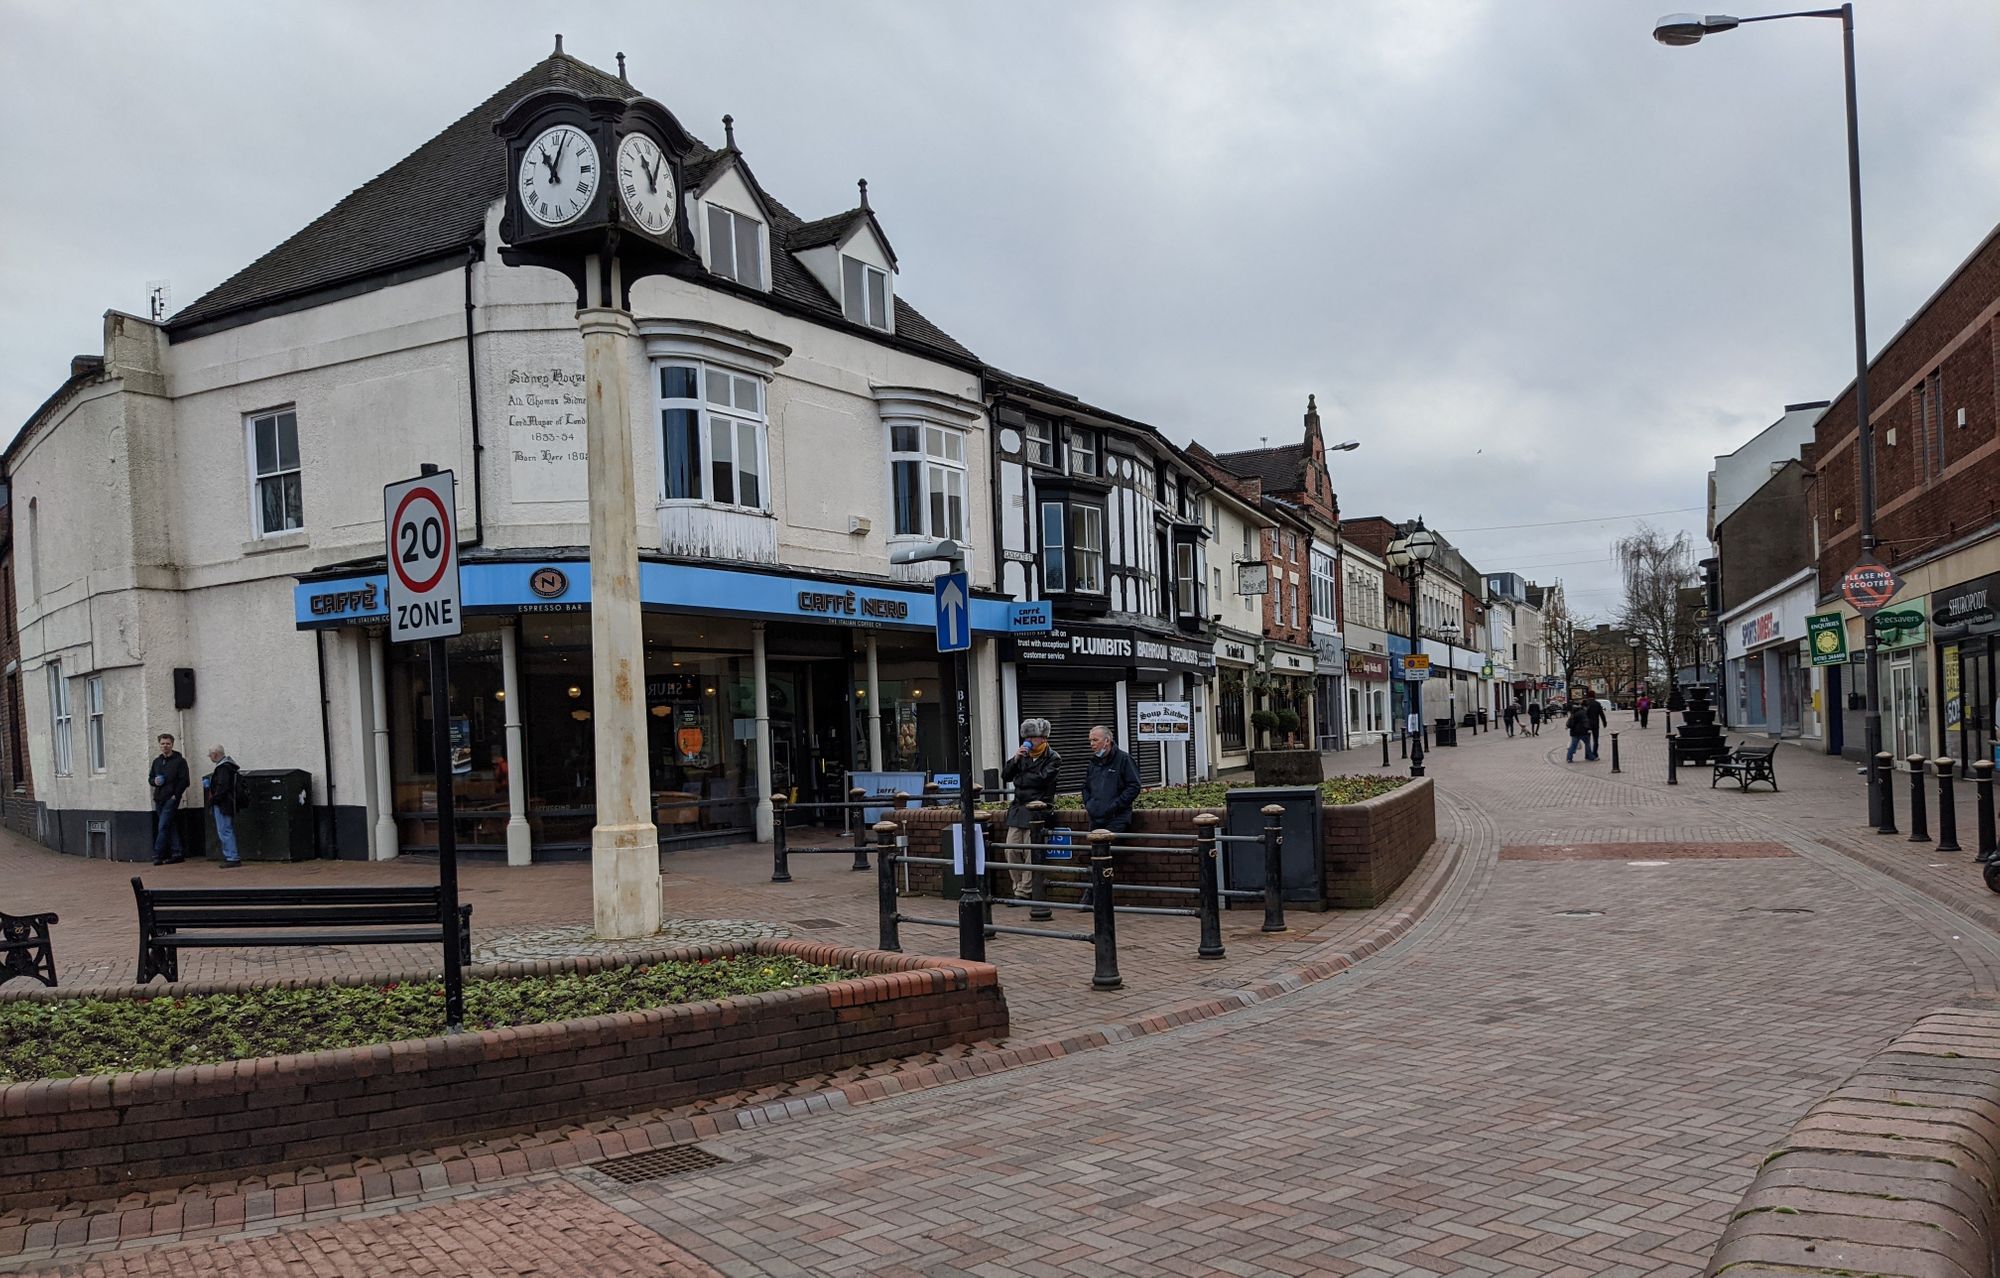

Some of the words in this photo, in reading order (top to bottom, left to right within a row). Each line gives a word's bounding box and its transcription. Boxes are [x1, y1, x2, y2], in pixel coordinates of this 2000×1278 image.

[509, 369, 549, 388] Sidney
[526, 393, 559, 408] Thomas
[563, 392, 586, 405] Sidne
[509, 414, 526, 427] Lord
[526, 415, 554, 428] Mayor
[556, 415, 563, 426] of
[565, 412, 586, 426] Lond
[531, 432, 575, 442] 1853-54
[512, 450, 537, 462] Born
[540, 449, 563, 464] Here
[401, 516, 442, 564] 20
[542, 575, 555, 588] N
[1844, 572, 1875, 582] PLEASE
[1877, 571, 1891, 579] NO
[1841, 579, 1895, 590] E-SCOOTERS
[518, 604, 562, 613] ESPRESSO
[566, 603, 583, 611] BAR
[860, 597, 908, 618] NERO
[1949, 589, 1988, 617] SHUROPODY
[397, 598, 453, 640] ZONE
[1013, 615, 1046, 626] NERO
[1811, 621, 1840, 630] ENQUIRIES
[1017, 639, 1030, 647] trust
[1031, 639, 1041, 648] with
[1042, 641, 1070, 650] exceptional
[1071, 636, 1132, 657] PLUMBITS
[1047, 652, 1065, 660] service
[1136, 640, 1168, 660] BATHROOM
[1169, 646, 1198, 666] SPECIALISTS
[1140, 710, 1162, 721] Soup
[1162, 707, 1189, 721] Kitchen
